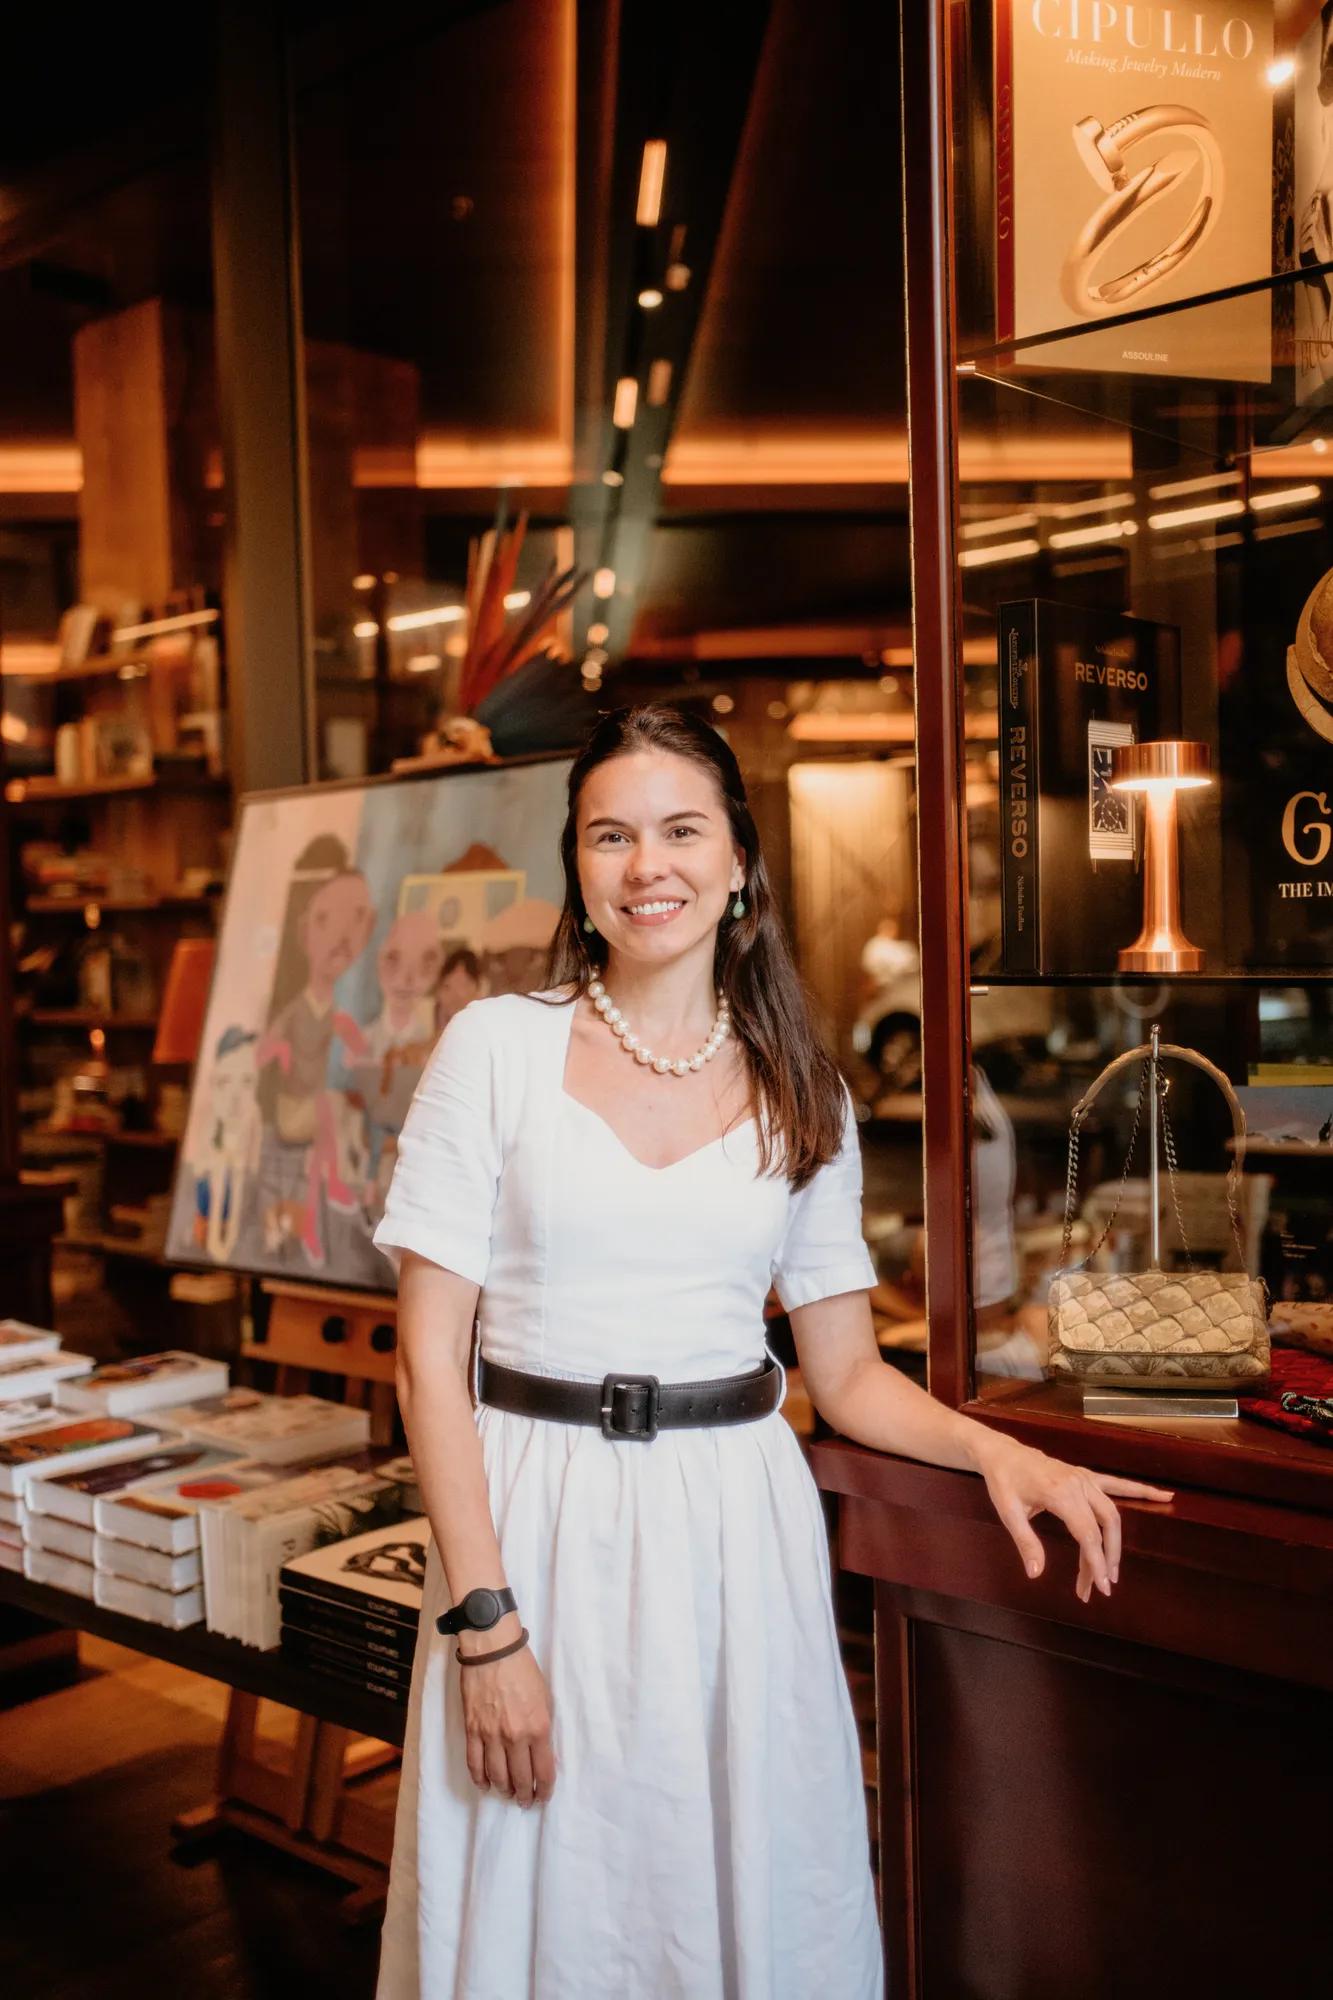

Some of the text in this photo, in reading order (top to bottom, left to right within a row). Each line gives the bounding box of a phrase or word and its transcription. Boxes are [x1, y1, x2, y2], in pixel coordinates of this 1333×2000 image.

[1032, 0, 1254, 60] CIPULLO
[1065, 49, 1221, 81] Making Jewelry Modern
[1122, 351, 1169, 362] ASSOULINE
[1075, 662, 1148, 691] REVERSO
[1010, 726, 1028, 858] REVERSO
[1279, 882, 1313, 898] THE
